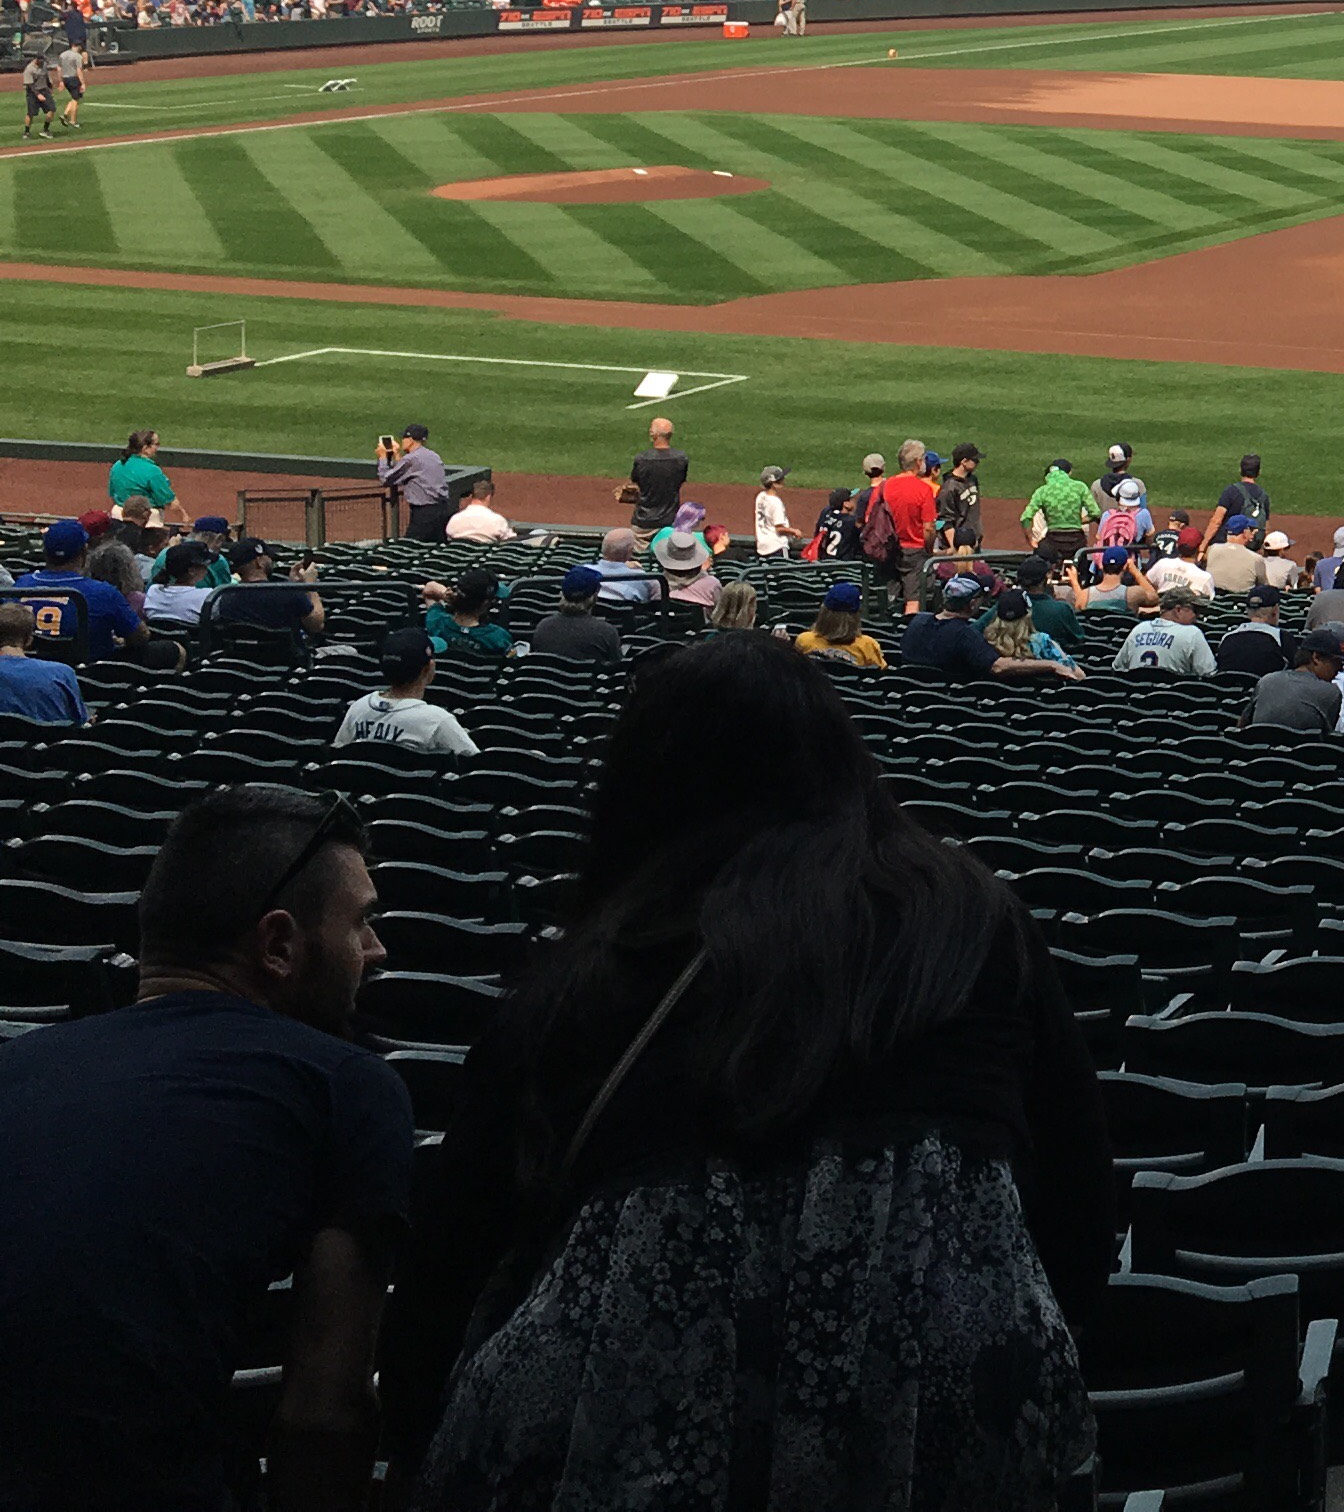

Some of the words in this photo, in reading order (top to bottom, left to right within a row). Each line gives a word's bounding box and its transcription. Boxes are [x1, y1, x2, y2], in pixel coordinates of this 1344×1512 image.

[411, 14, 443, 28] ROOT
[1134, 631, 1175, 650] SEGURA
[354, 720, 405, 742] HEALY
